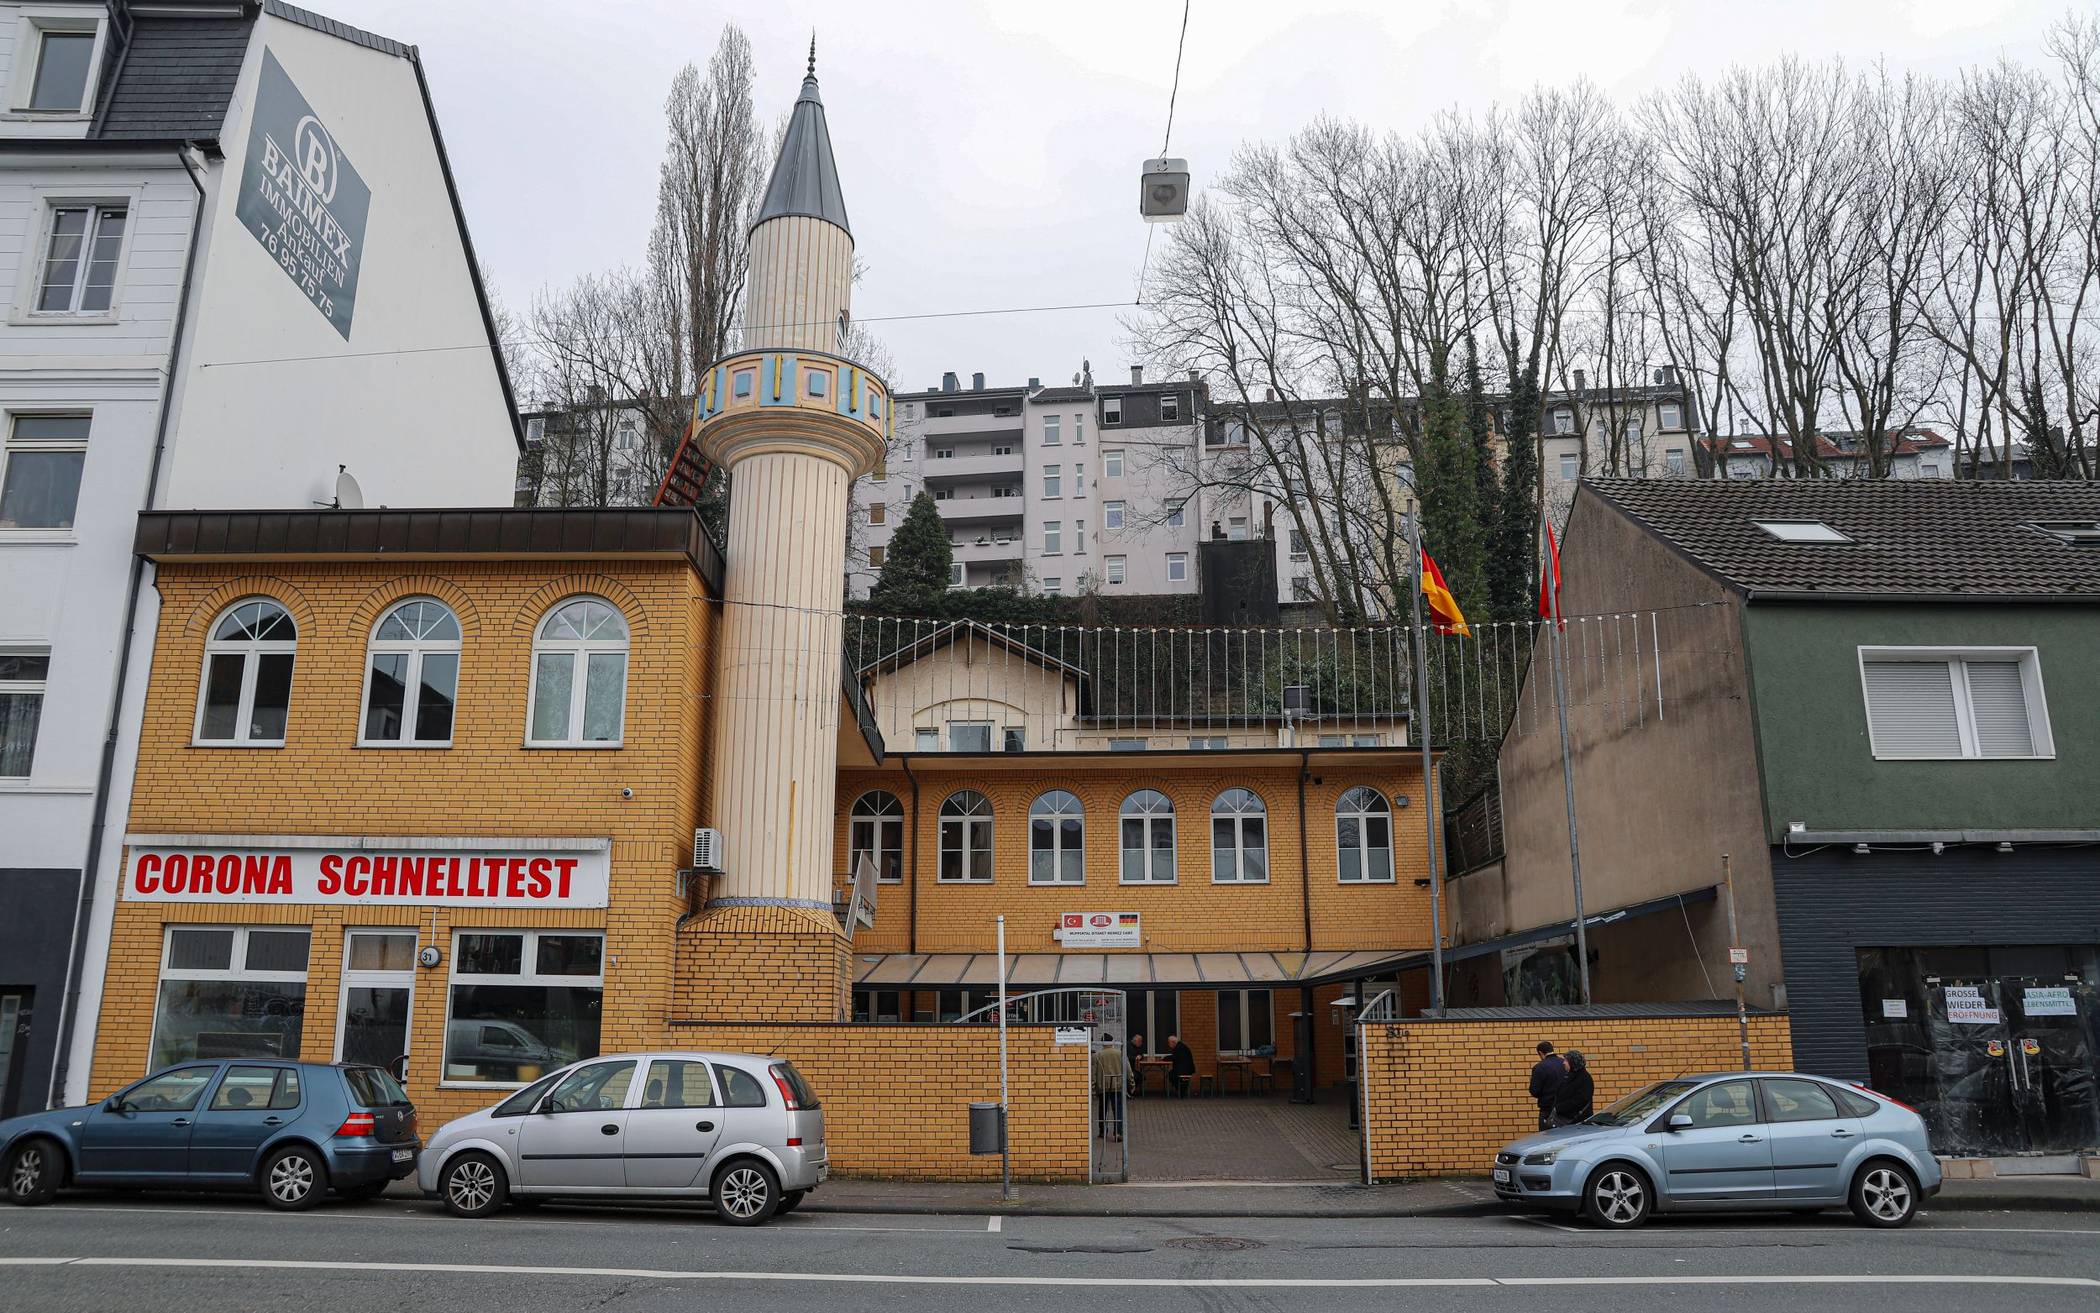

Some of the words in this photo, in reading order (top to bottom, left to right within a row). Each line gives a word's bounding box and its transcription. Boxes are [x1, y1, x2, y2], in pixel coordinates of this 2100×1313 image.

[259, 174, 345, 288] IMMOBILIEN
[261, 137, 351, 269] BAIMEX
[260, 223, 278, 254] 76
[280, 249, 297, 277] 95
[300, 269, 316, 299] 75
[318, 290, 334, 319] 75
[276, 222, 326, 287] Ankauf
[134, 853, 294, 895] CORONA
[317, 854, 579, 899] SCHNELLTEST
[1946, 990, 1977, 998] GROSSE
